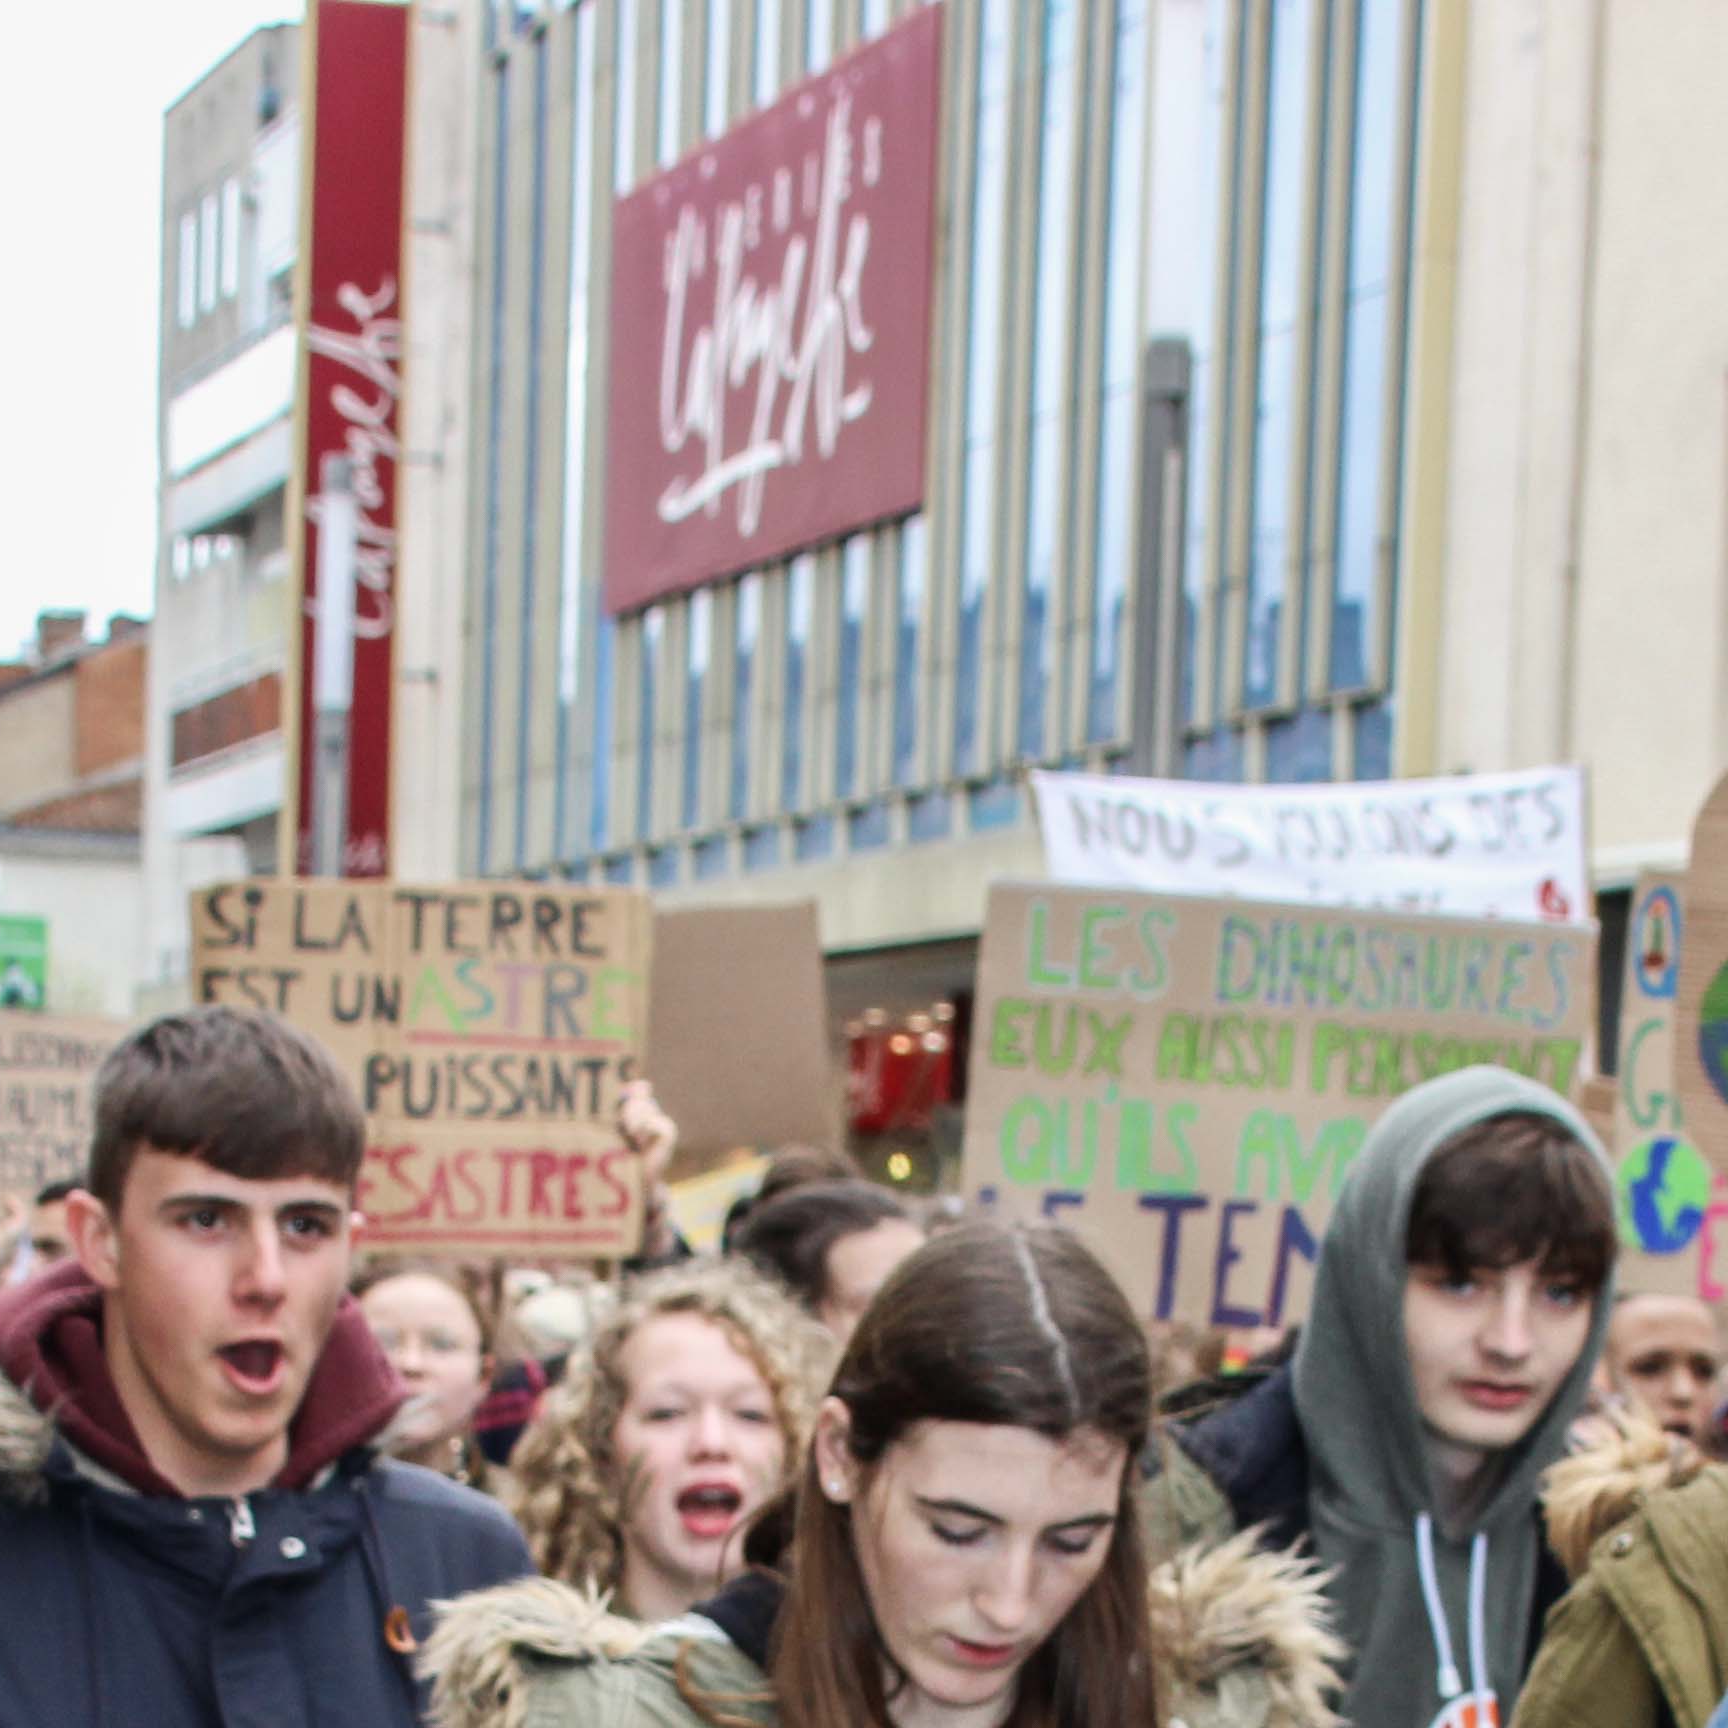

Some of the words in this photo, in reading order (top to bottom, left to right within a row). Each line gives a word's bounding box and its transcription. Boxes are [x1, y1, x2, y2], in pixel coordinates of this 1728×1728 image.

[294, 892, 370, 952] LA
[396, 893, 607, 957] TERRE
[1027, 902, 1176, 992] LES
[1217, 914, 1575, 1030] DINOSAURES
[331, 972, 402, 1023] UN
[408, 957, 642, 1040] ASTRE
[989, 1000, 1133, 1077] EUX
[1154, 1009, 1294, 1089] AUSSI
[999, 1080, 1201, 1197] QU'ILS
